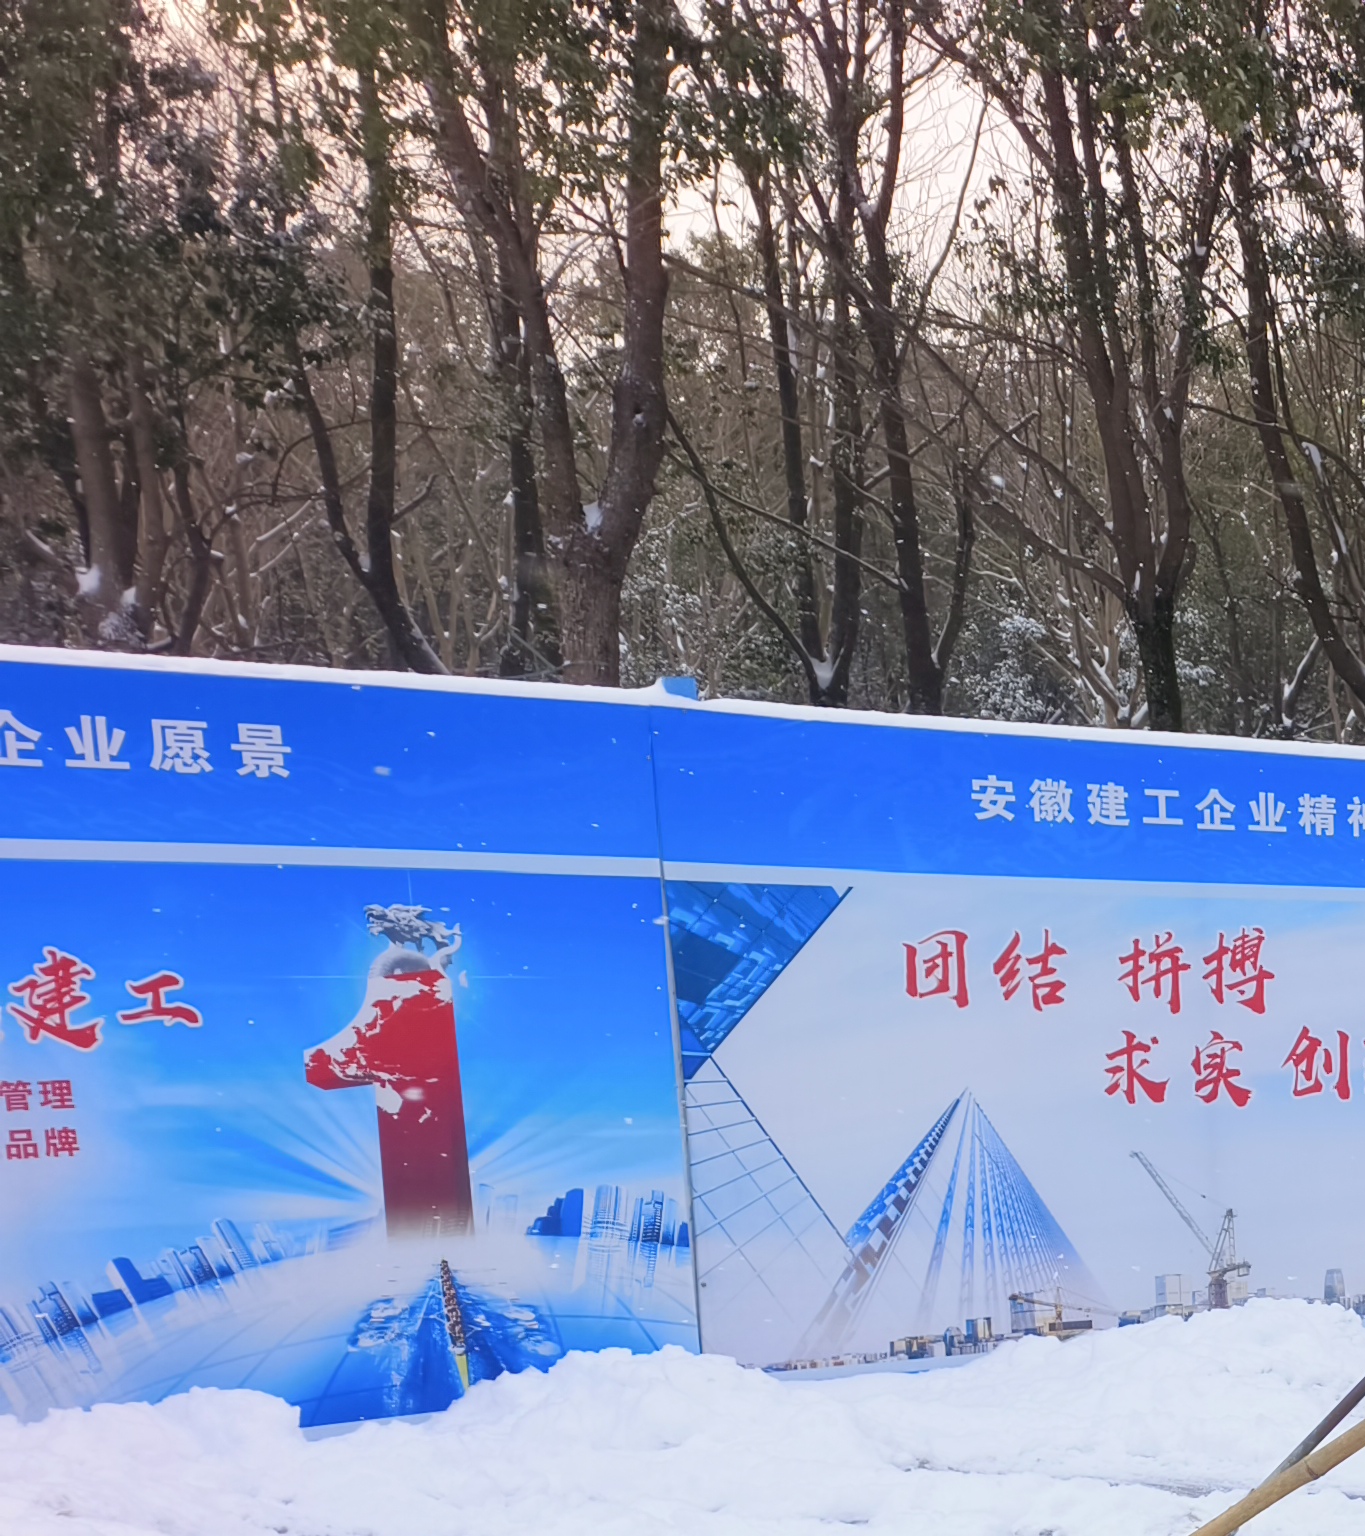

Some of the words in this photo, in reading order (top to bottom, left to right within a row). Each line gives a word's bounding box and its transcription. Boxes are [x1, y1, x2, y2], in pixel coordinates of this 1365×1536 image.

[0, 709, 292, 778] 企业愿景
[901, 928, 1068, 1013] 团结
[1118, 926, 1276, 1015] 拼搏
[1103, 1029, 1253, 1108] 求实
[6, 1127, 80, 1160] 品牌
